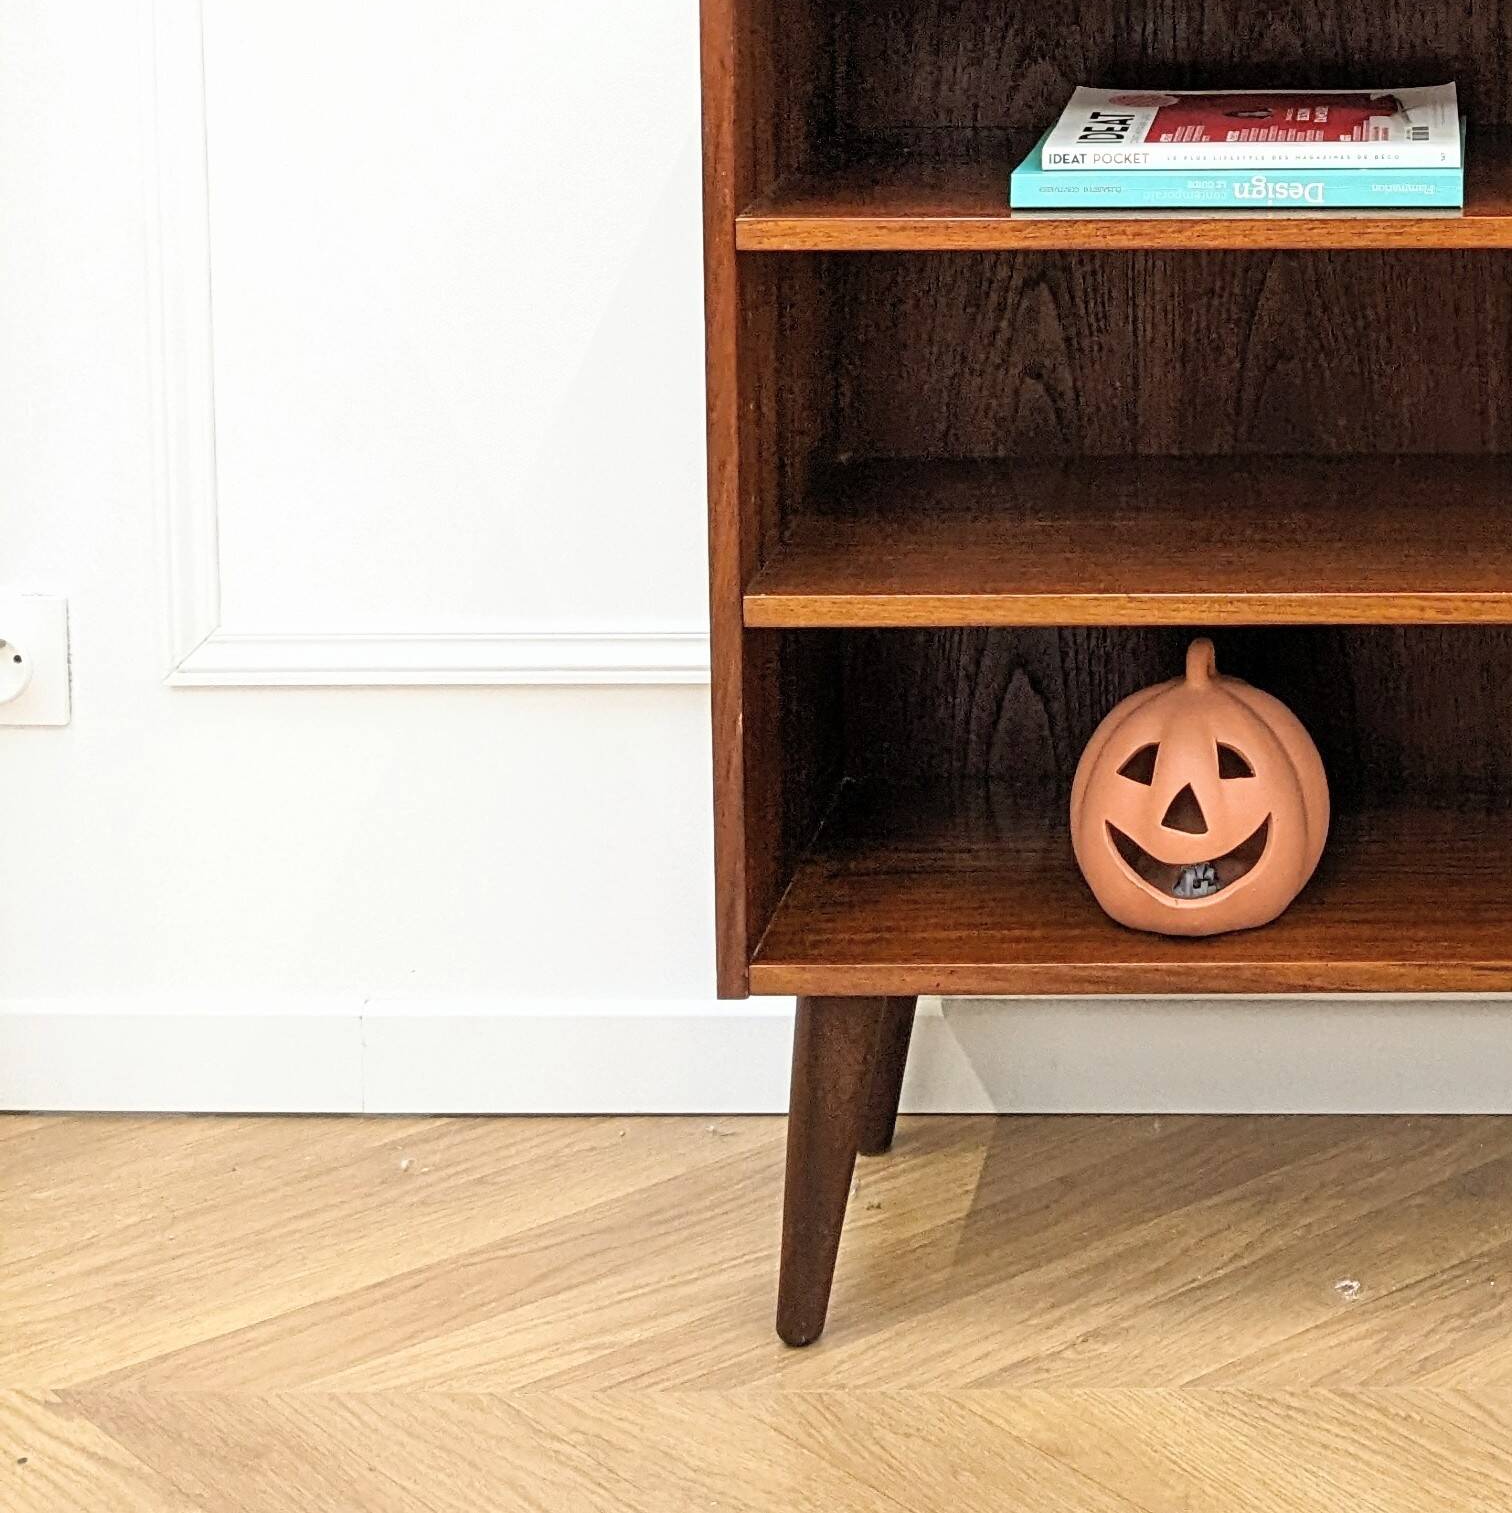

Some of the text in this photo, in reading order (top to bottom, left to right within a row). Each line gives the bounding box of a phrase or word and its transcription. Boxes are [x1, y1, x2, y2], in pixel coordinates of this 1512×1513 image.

[1076, 111, 1136, 144] IDEAT
[1048, 152, 1150, 165] IDEAT POCKET
[1234, 175, 1325, 204] Design
